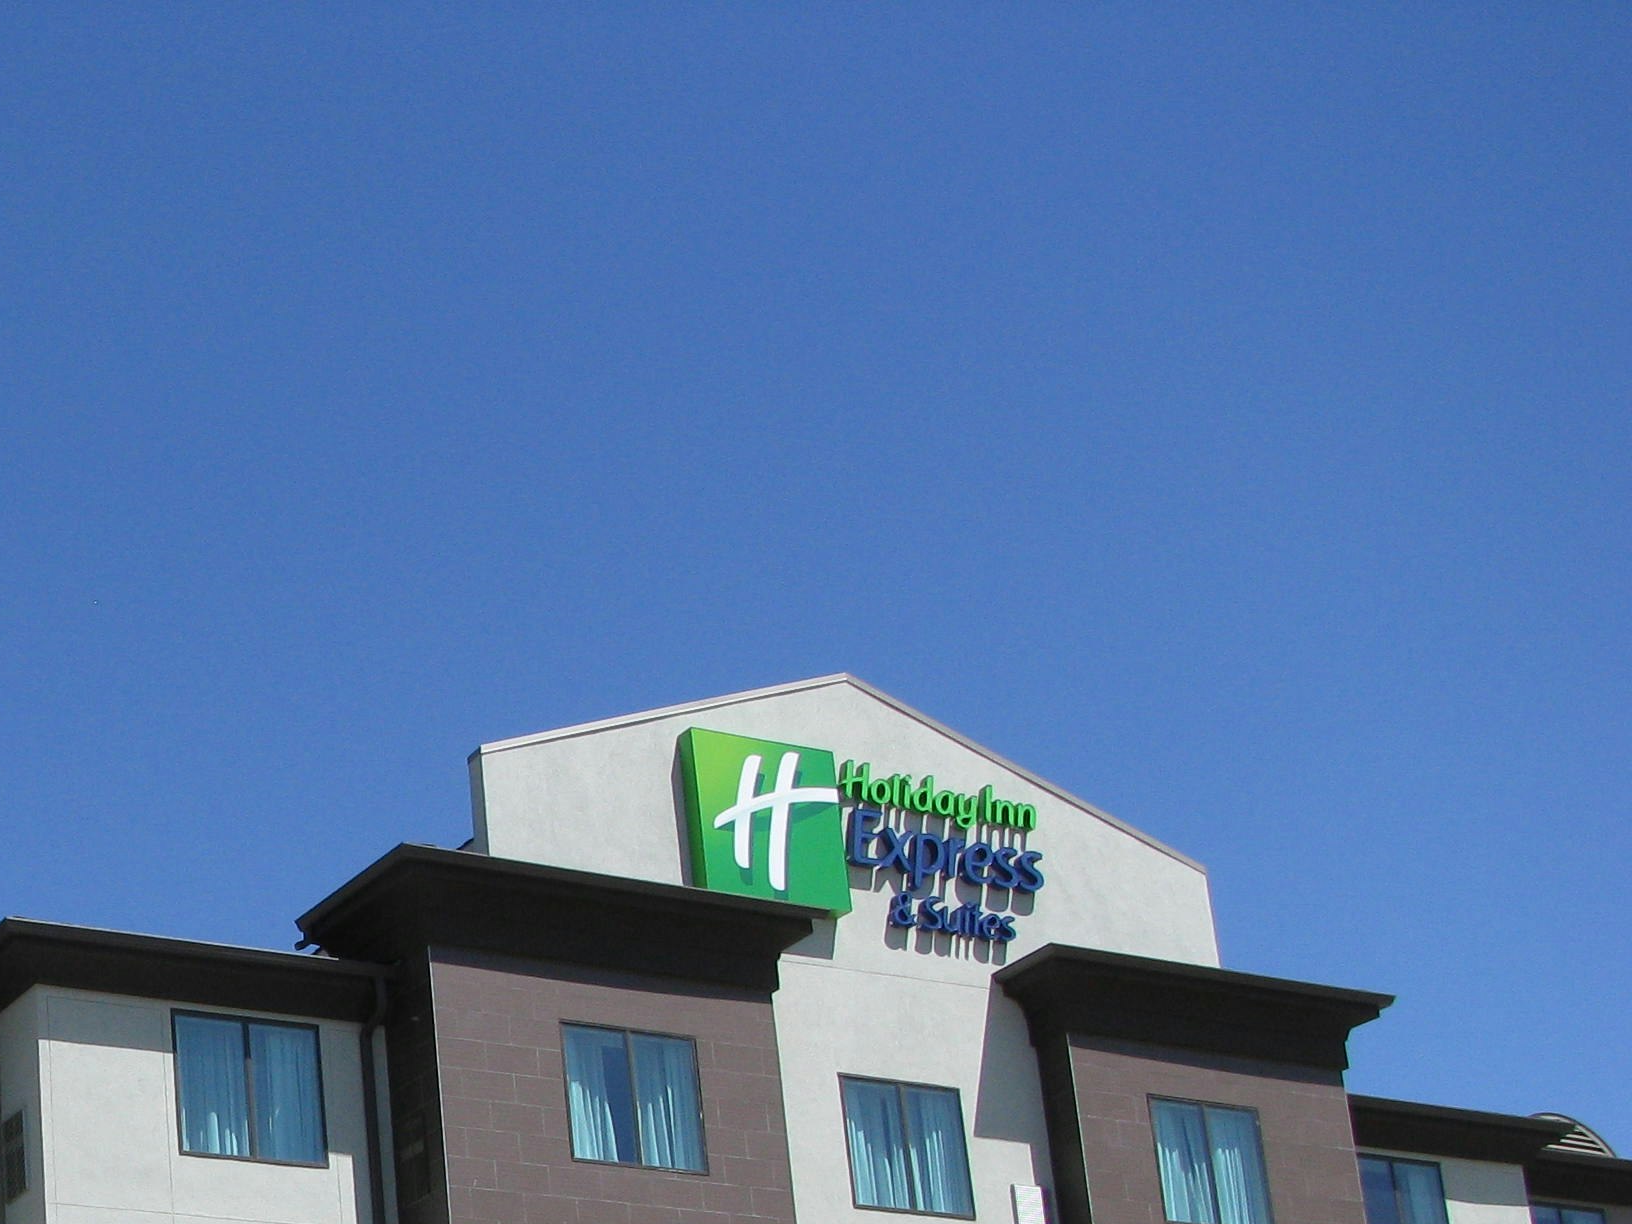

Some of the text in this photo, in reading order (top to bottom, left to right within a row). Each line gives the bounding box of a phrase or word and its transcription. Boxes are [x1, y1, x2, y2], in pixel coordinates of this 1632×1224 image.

[840, 759, 1037, 831] Holiday Inn
[847, 808, 1045, 893] Express
[890, 892, 1016, 943] & Suites
